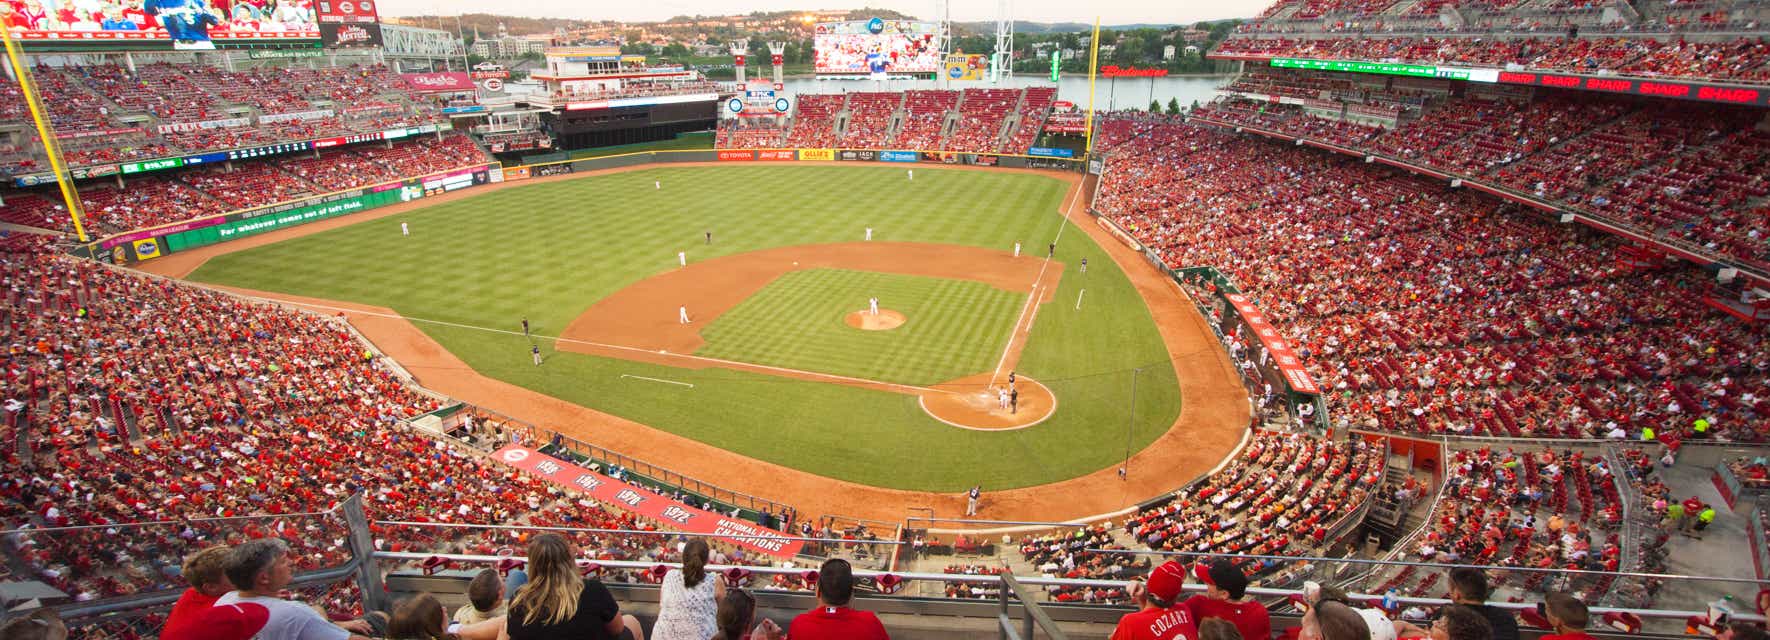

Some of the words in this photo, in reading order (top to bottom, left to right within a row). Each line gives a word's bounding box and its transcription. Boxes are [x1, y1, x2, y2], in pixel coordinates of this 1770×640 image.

[1500, 72, 1536, 83] SHARP
[1540, 76, 1580, 87] SHARP
[1586, 79, 1631, 91] SHARP
[1640, 82, 1689, 97] SHARP
[1698, 86, 1758, 102] SHARP
[220, 228, 236, 236] For
[238, 220, 276, 232] whatever
[278, 214, 303, 224] comes
[304, 210, 317, 219] out
[328, 205, 343, 213] left
[343, 201, 363, 210] field.
[664, 506, 690, 523] 1972
[714, 527, 782, 552] CHAMPIONS
[717, 518, 758, 535] NATIONAL
[759, 529, 793, 545] LEAGUE
[1150, 610, 1188, 637] COZART
